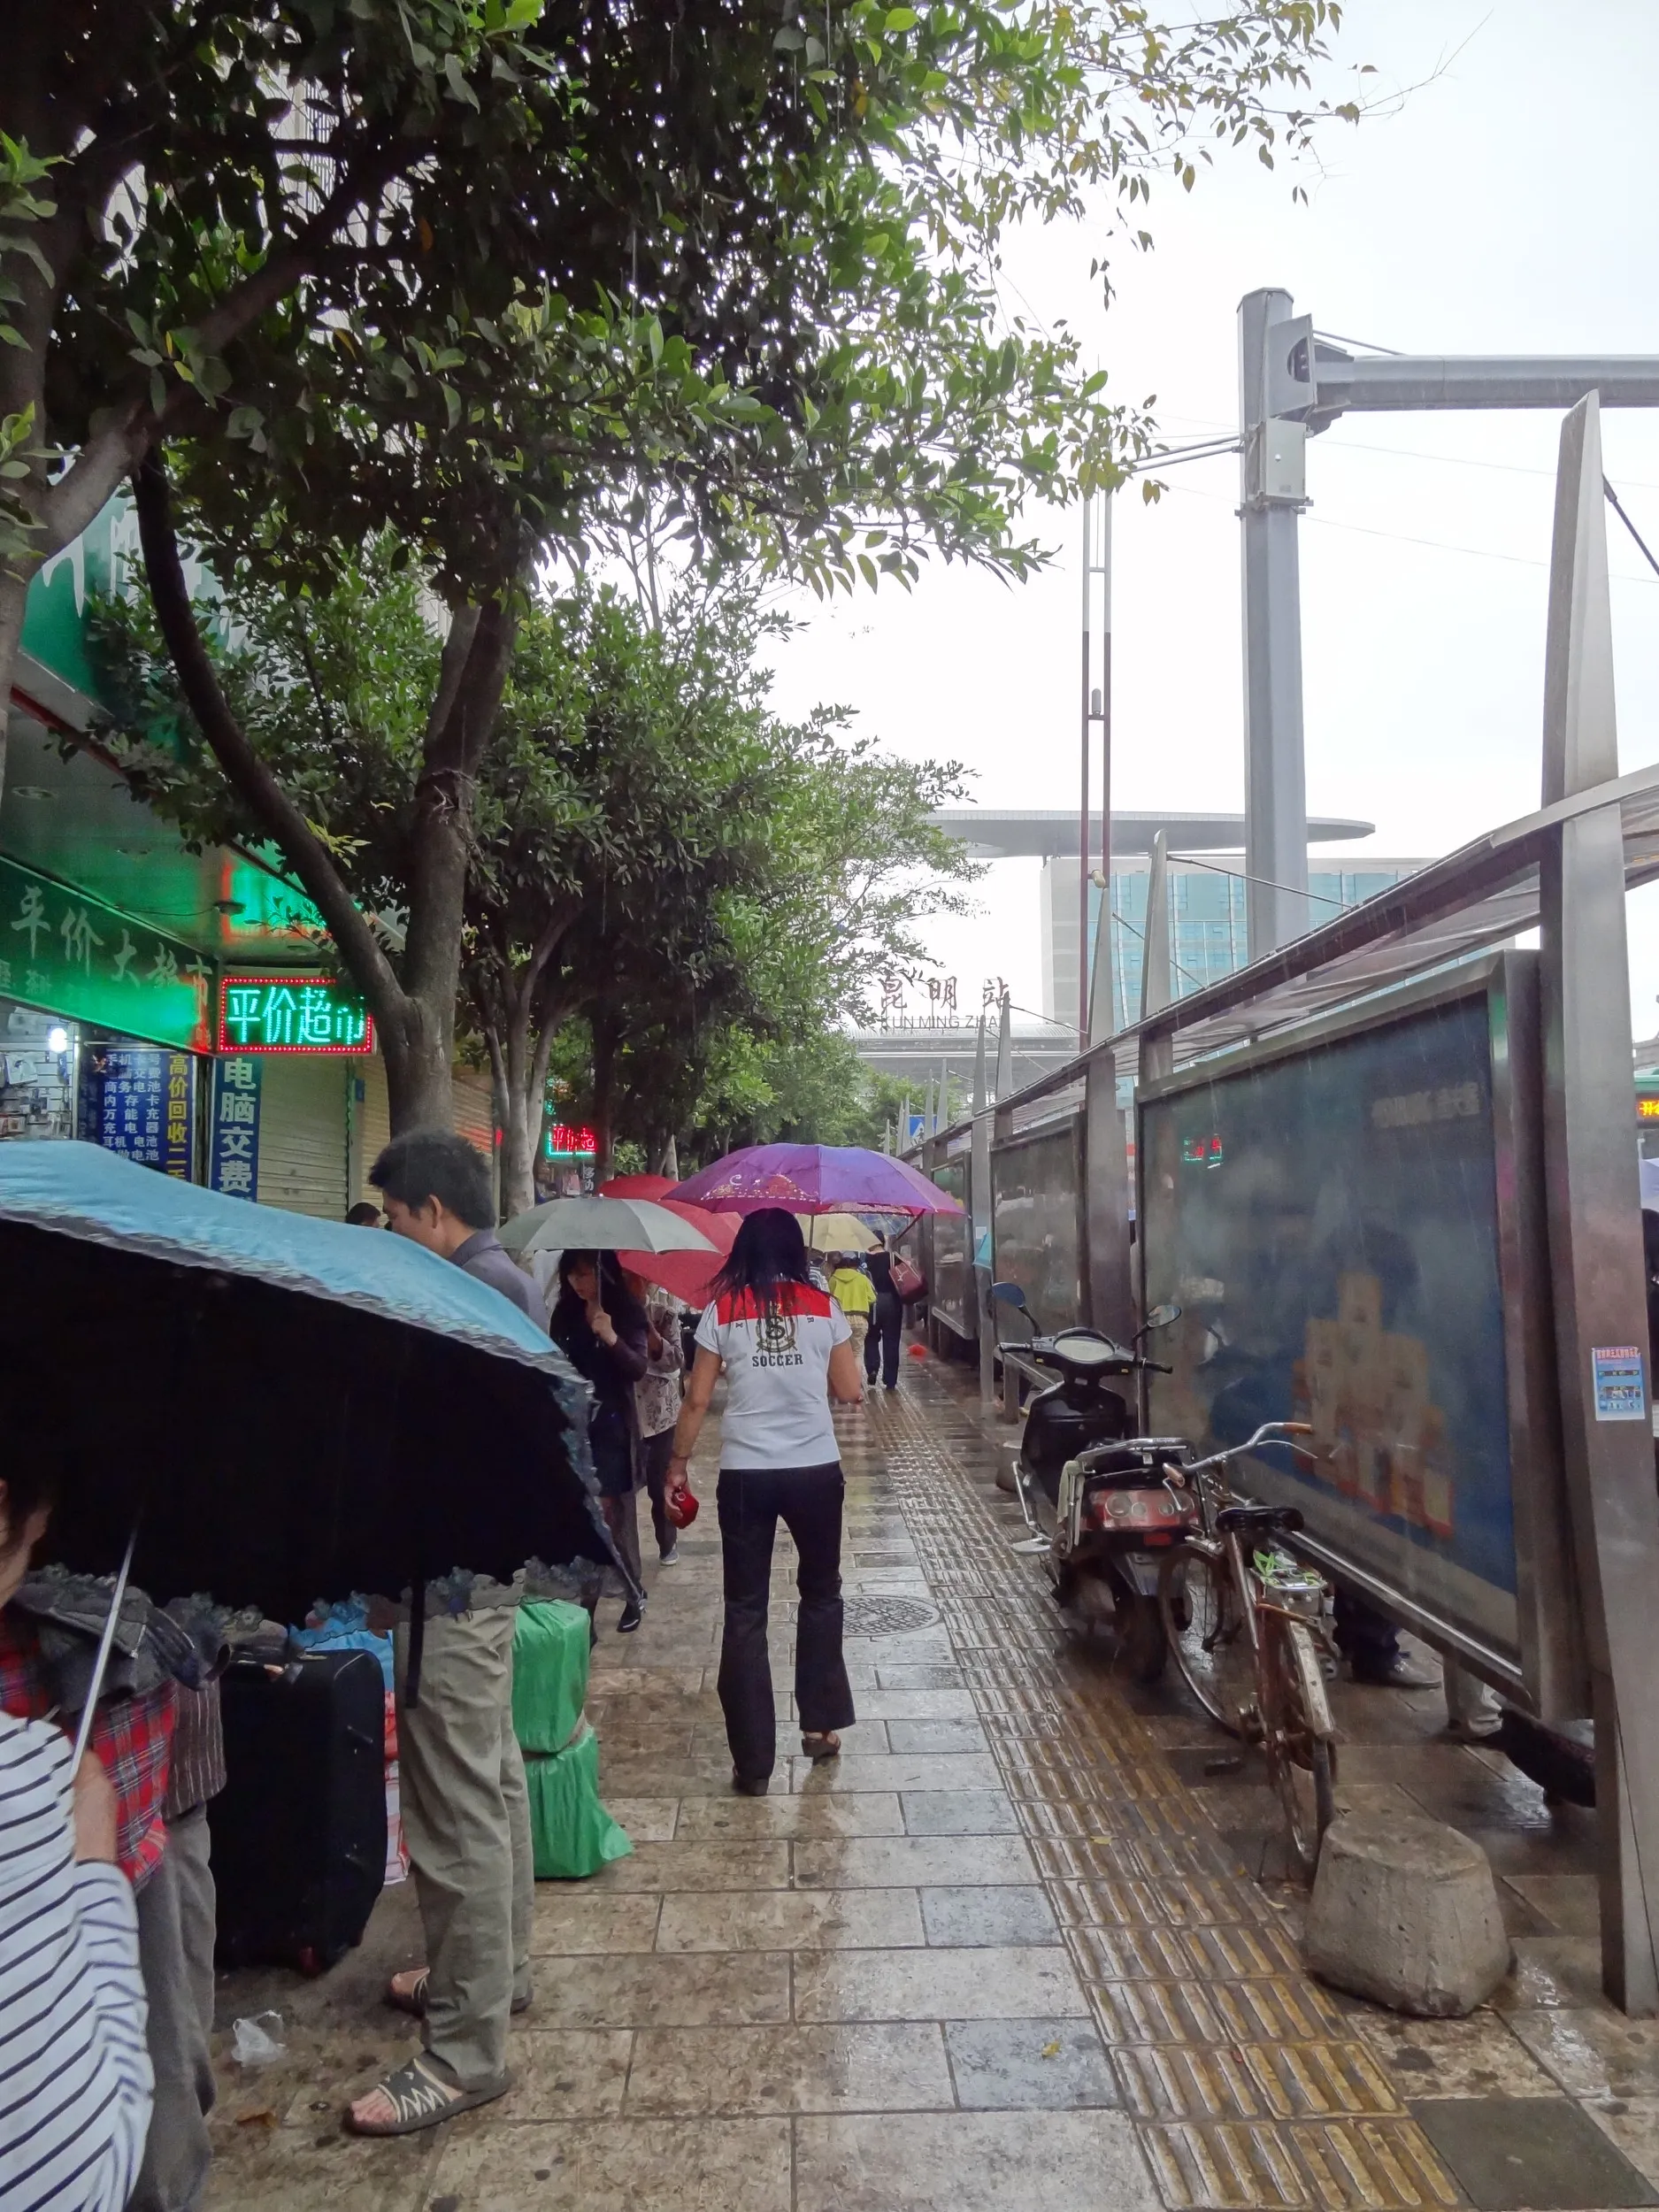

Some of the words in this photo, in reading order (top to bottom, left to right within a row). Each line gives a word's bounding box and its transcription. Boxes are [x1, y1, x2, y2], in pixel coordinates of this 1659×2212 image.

[879, 975, 1010, 1010] 昆明站
[920, 1016, 960, 1028] MING
[965, 1016, 1002, 1028] ZHA
[104, 1080, 161, 1094] 商务电池
[104, 1094, 160, 1107] 内存卡
[103, 1108, 160, 1121] 万能充
[104, 1122, 159, 1134] 充电器
[218, 1057, 257, 1201] 电脑交费
[752, 1354, 803, 1368] SOCCER
